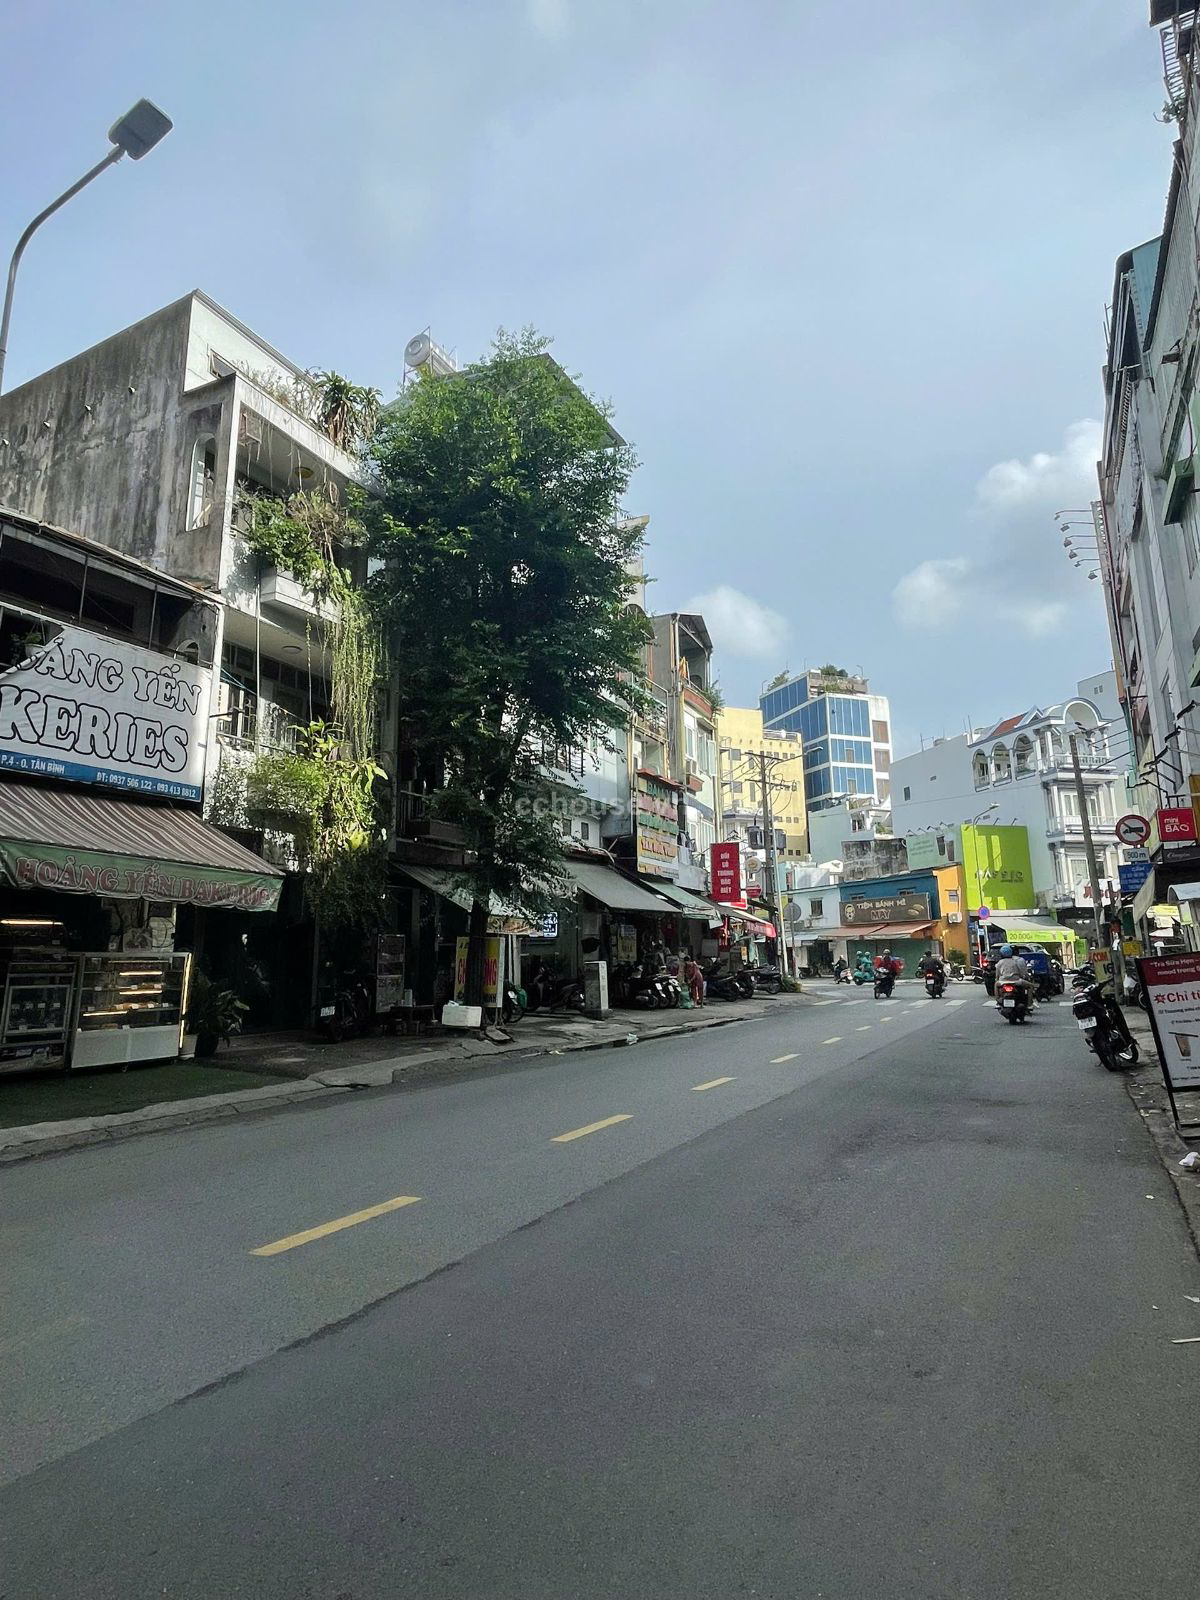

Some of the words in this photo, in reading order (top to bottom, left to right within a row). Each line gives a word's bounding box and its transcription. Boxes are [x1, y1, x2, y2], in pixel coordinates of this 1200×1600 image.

[19, 636, 124, 692] ÀNG
[132, 663, 202, 715] YẾN
[31, 759, 46, 771] TÂN
[47, 761, 65, 774] BÌNH
[109, 774, 125, 785] 0937
[141, 780, 152, 790] 122
[169, 786, 181, 796] 413
[1127, 851, 1139, 859] 500
[15, 856, 119, 892] HOÀNG
[125, 863, 175, 897] YẾN
[856, 901, 873, 910] TIỆM
[875, 899, 894, 908] BÁNH
